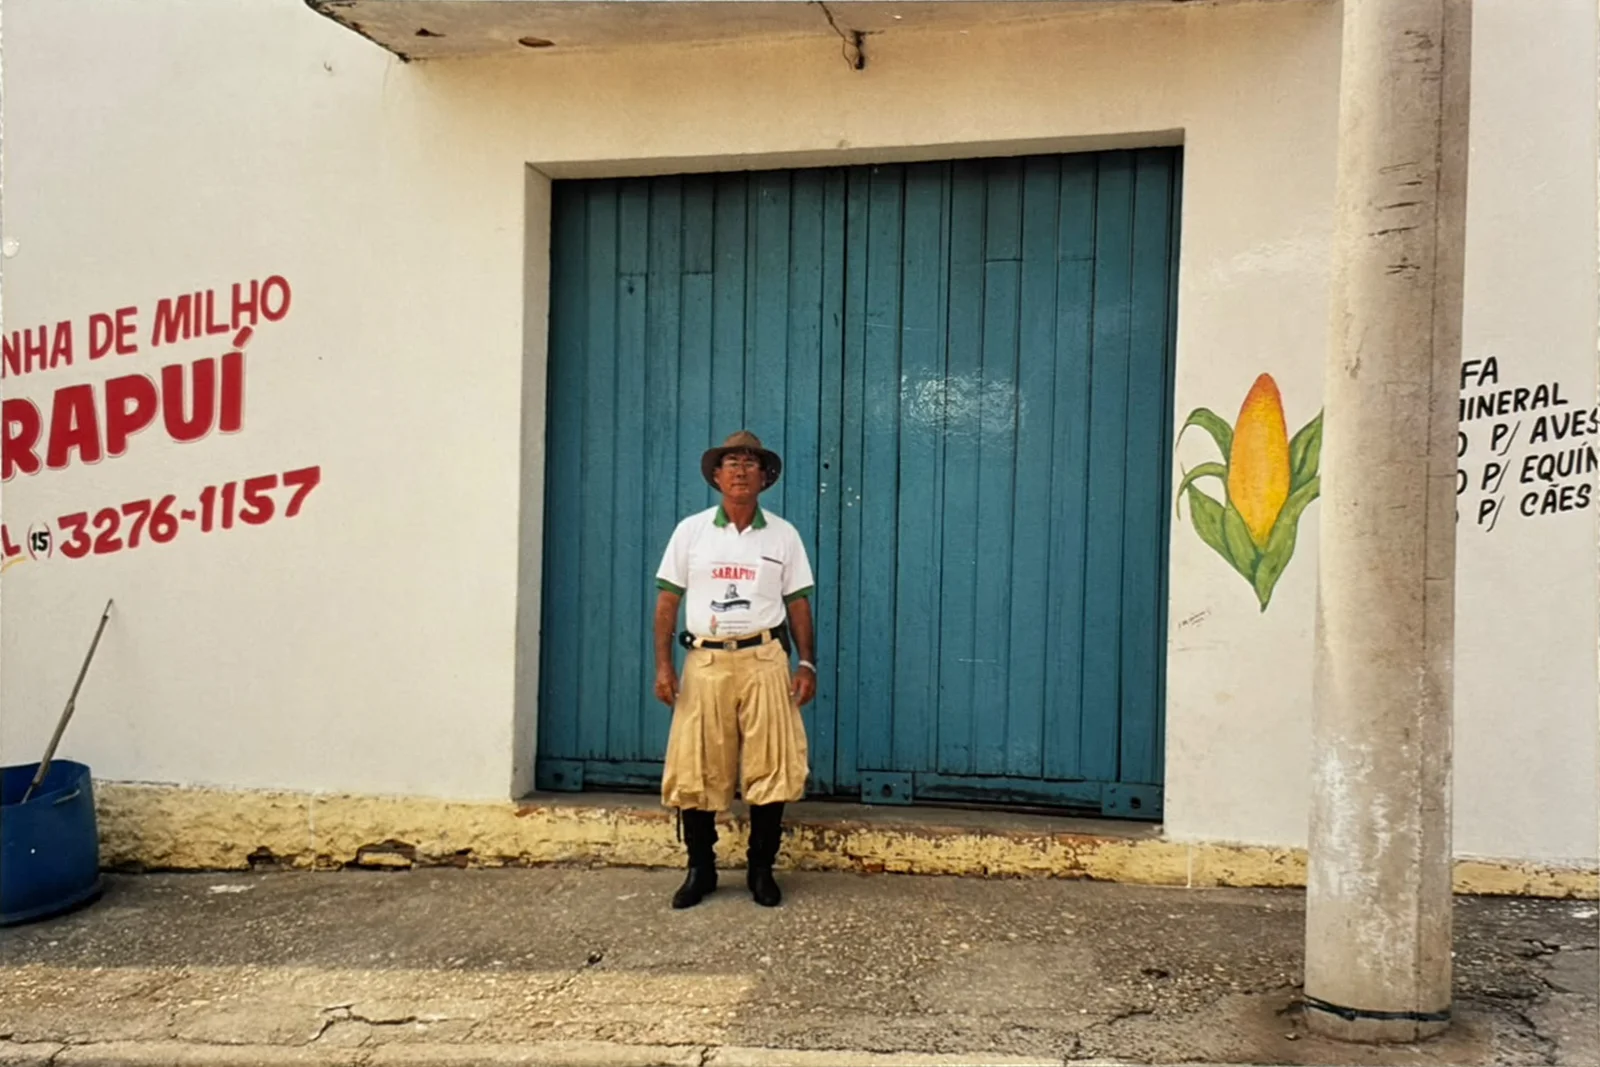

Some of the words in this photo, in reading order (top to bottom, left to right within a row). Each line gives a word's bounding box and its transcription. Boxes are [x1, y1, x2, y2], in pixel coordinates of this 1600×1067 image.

[89, 306, 138, 361] DE
[151, 275, 292, 347] MILHO
[1459, 356, 1498, 390] FA
[1, 325, 253, 482] RAPUÍ
[1529, 407, 1599, 445] AVES
[1520, 483, 1592, 517] CÃES
[1, 523, 22, 560] L
